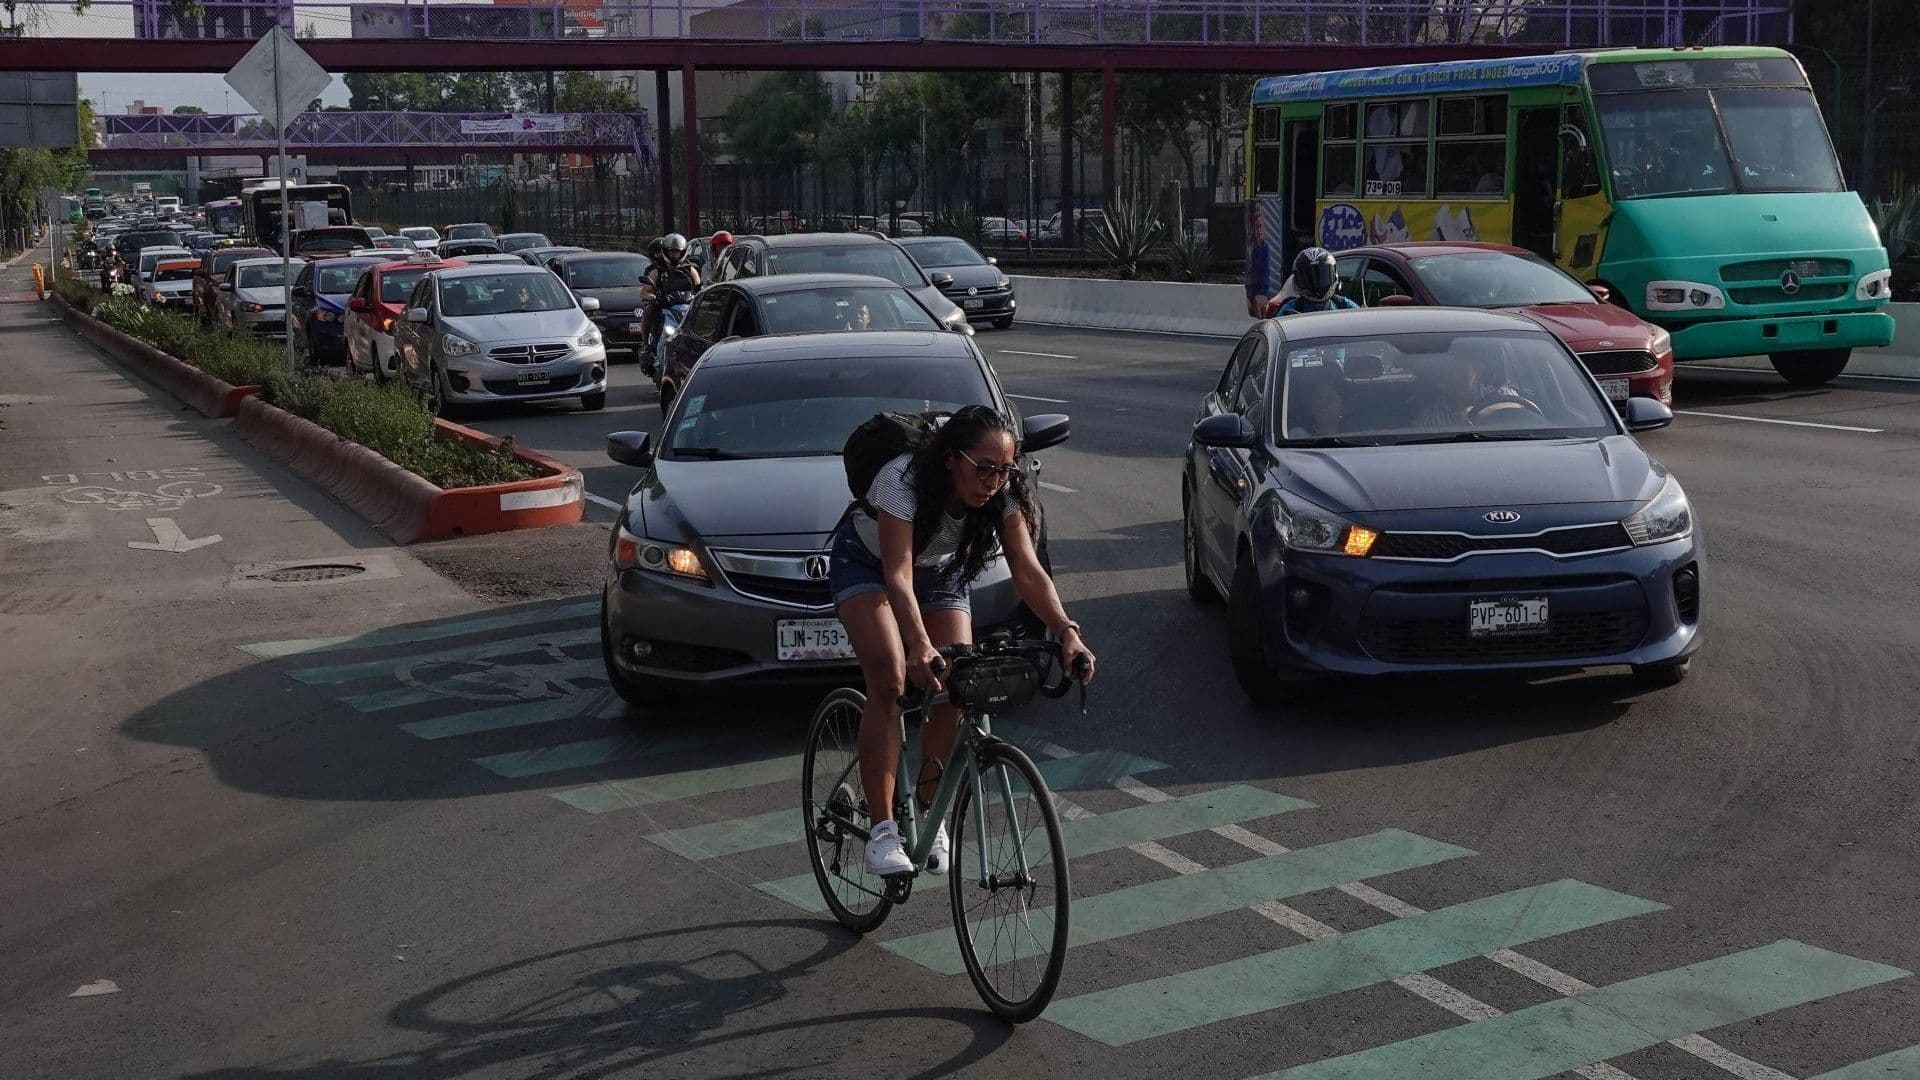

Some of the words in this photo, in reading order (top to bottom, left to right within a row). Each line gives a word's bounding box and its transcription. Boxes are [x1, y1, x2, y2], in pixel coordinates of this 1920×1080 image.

[1507, 60, 1560, 80] KangaROOS
[1490, 511, 1515, 520] KIA
[1471, 605, 1547, 625] PVP-601-C
[781, 629, 849, 648] LJN-753-
